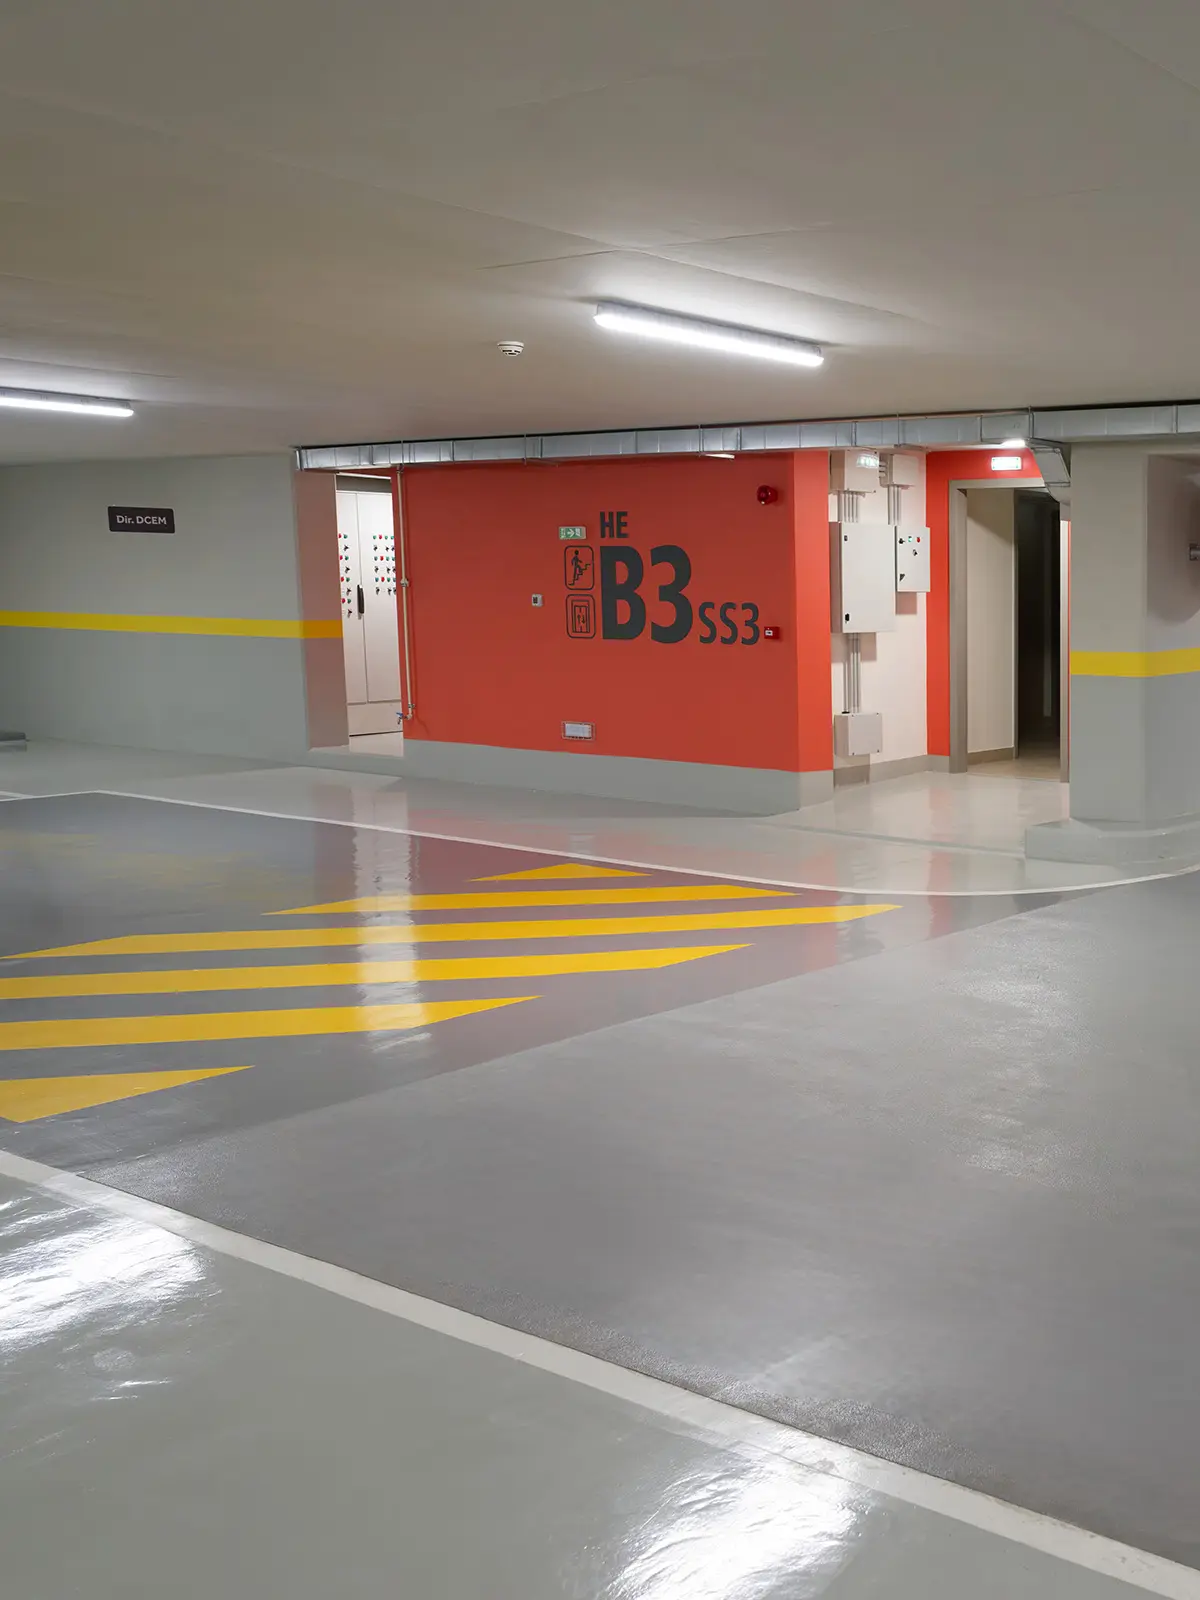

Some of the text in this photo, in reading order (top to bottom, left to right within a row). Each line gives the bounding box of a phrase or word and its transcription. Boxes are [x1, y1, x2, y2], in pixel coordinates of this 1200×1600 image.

[116, 515, 167, 525] Dir. DCEM
[600, 511, 629, 538] HE
[600, 545, 760, 645] B3 SS3
